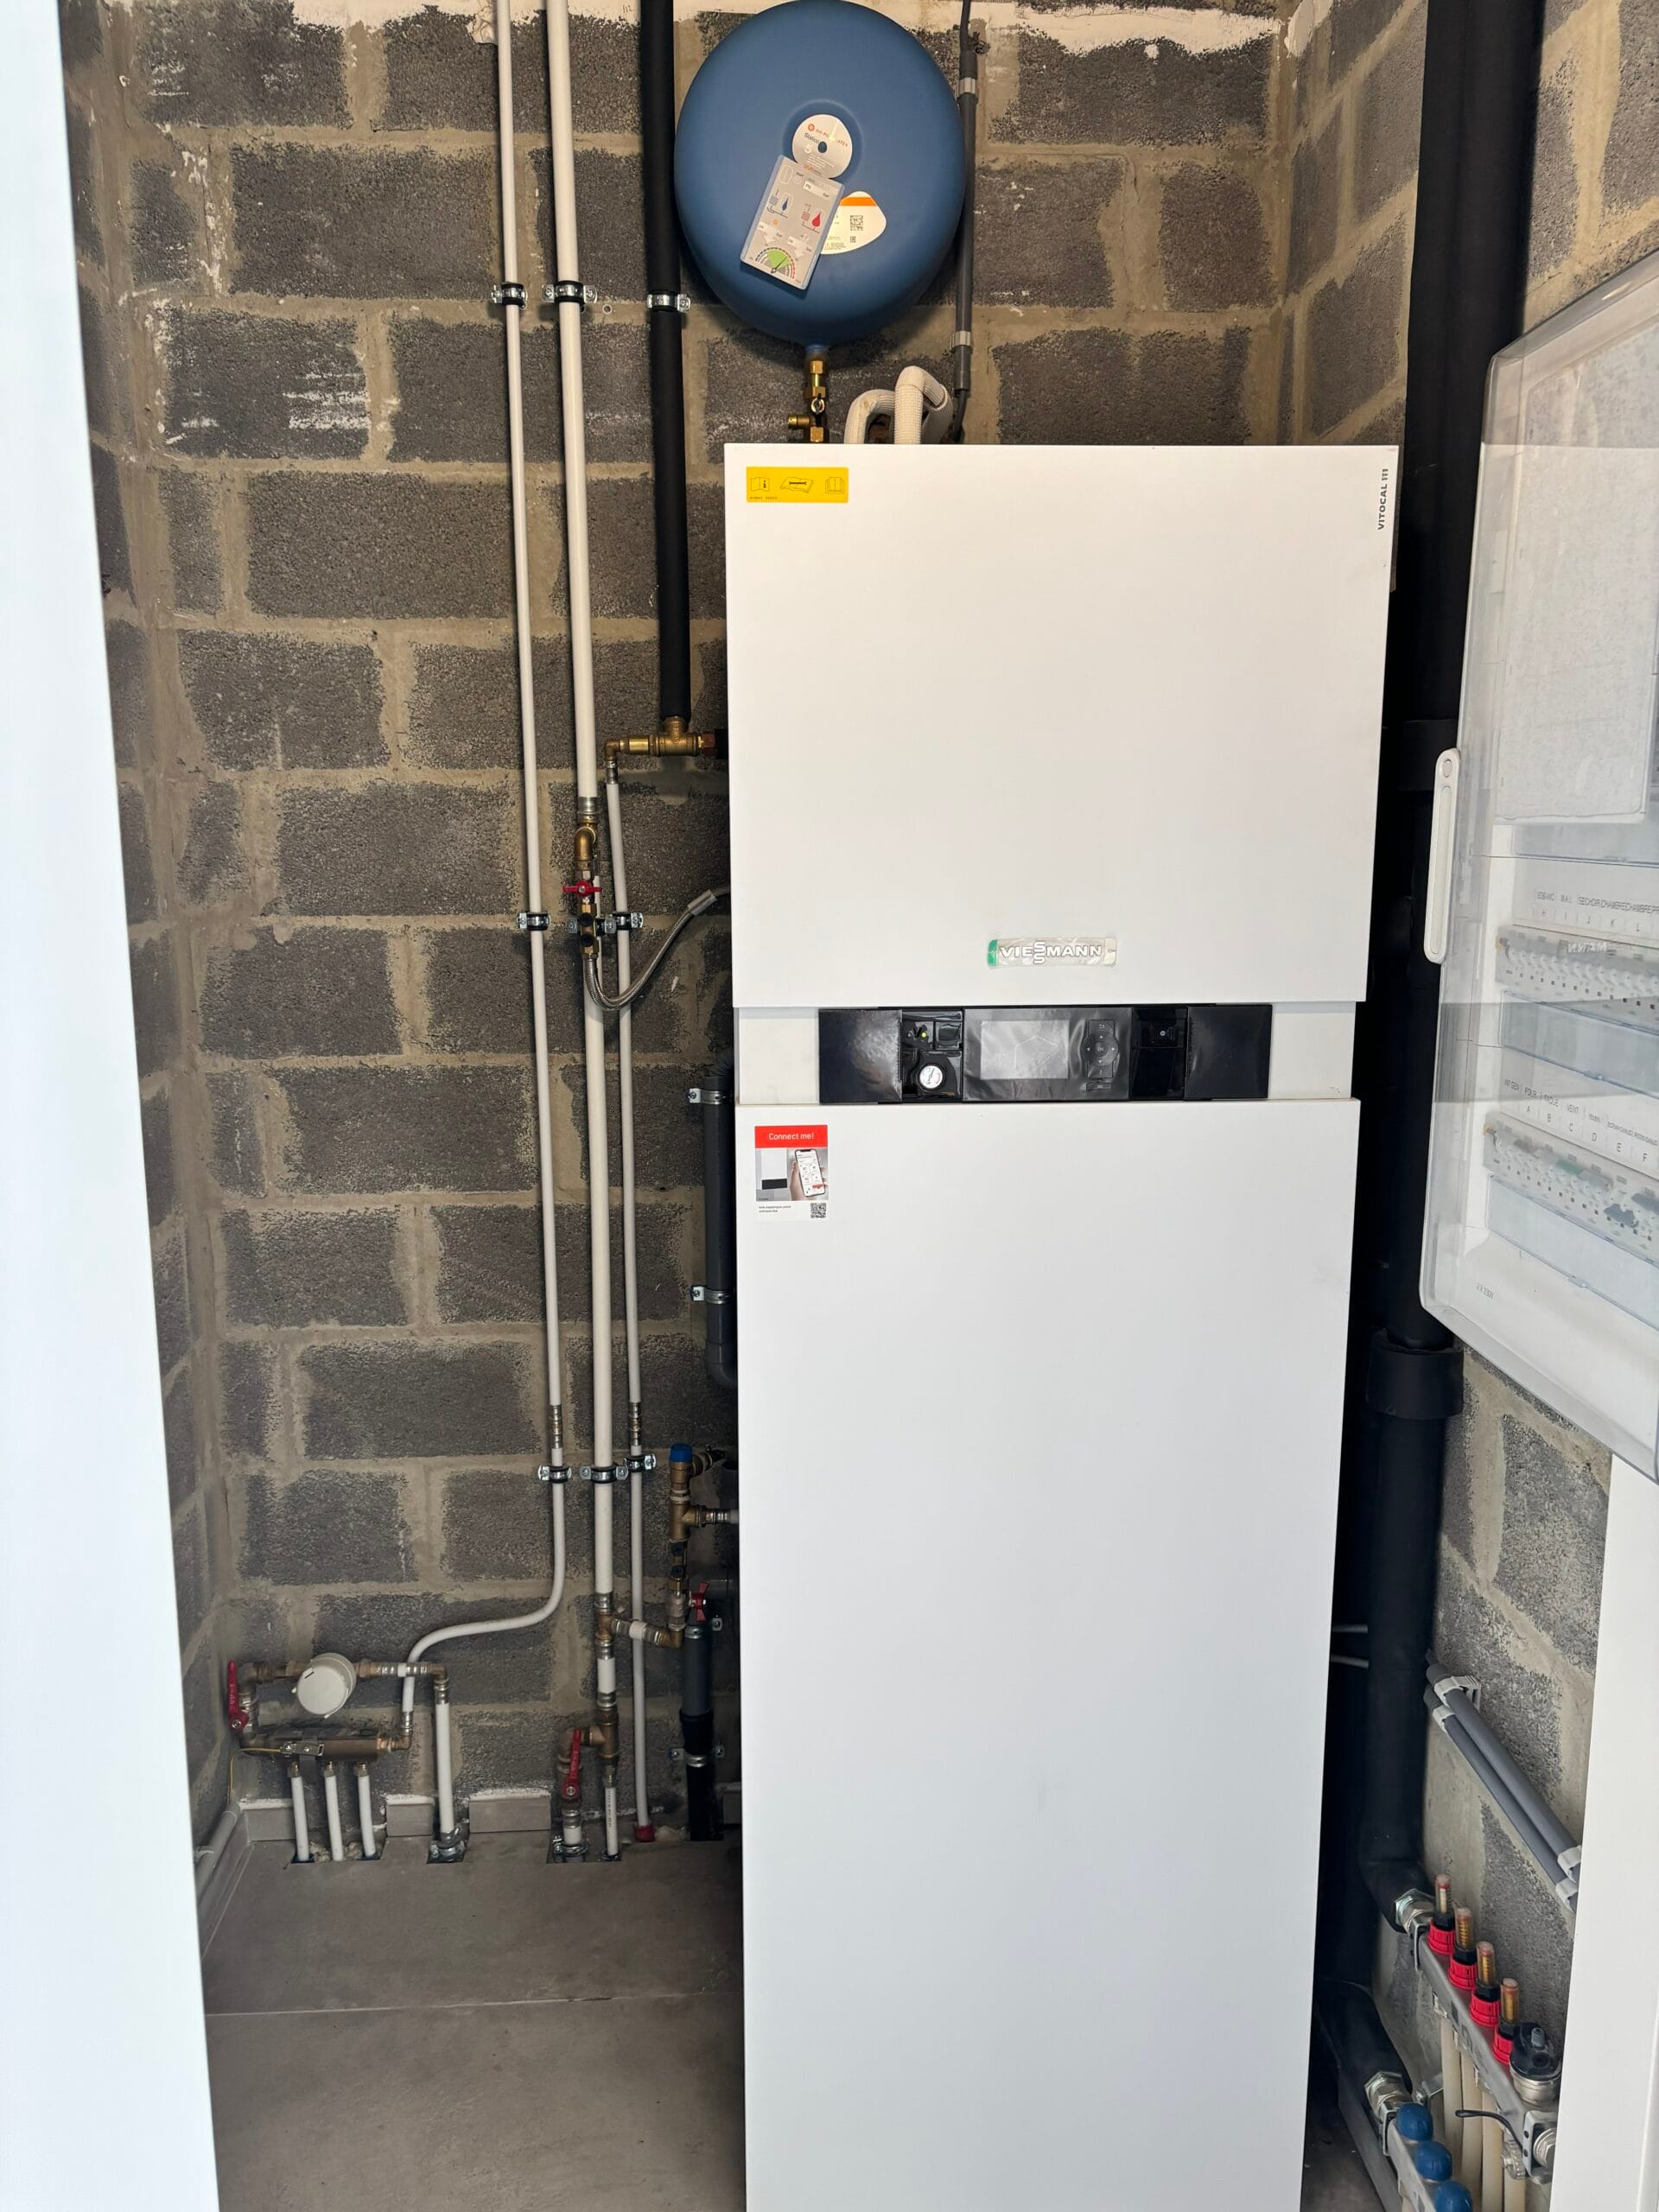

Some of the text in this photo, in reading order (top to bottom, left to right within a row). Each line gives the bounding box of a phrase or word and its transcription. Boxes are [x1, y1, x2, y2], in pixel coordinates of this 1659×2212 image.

[1377, 484, 1387, 530] VITOCAL
[1001, 941, 1102, 964] VIESSMANN
[768, 1132, 799, 1141] Connect
